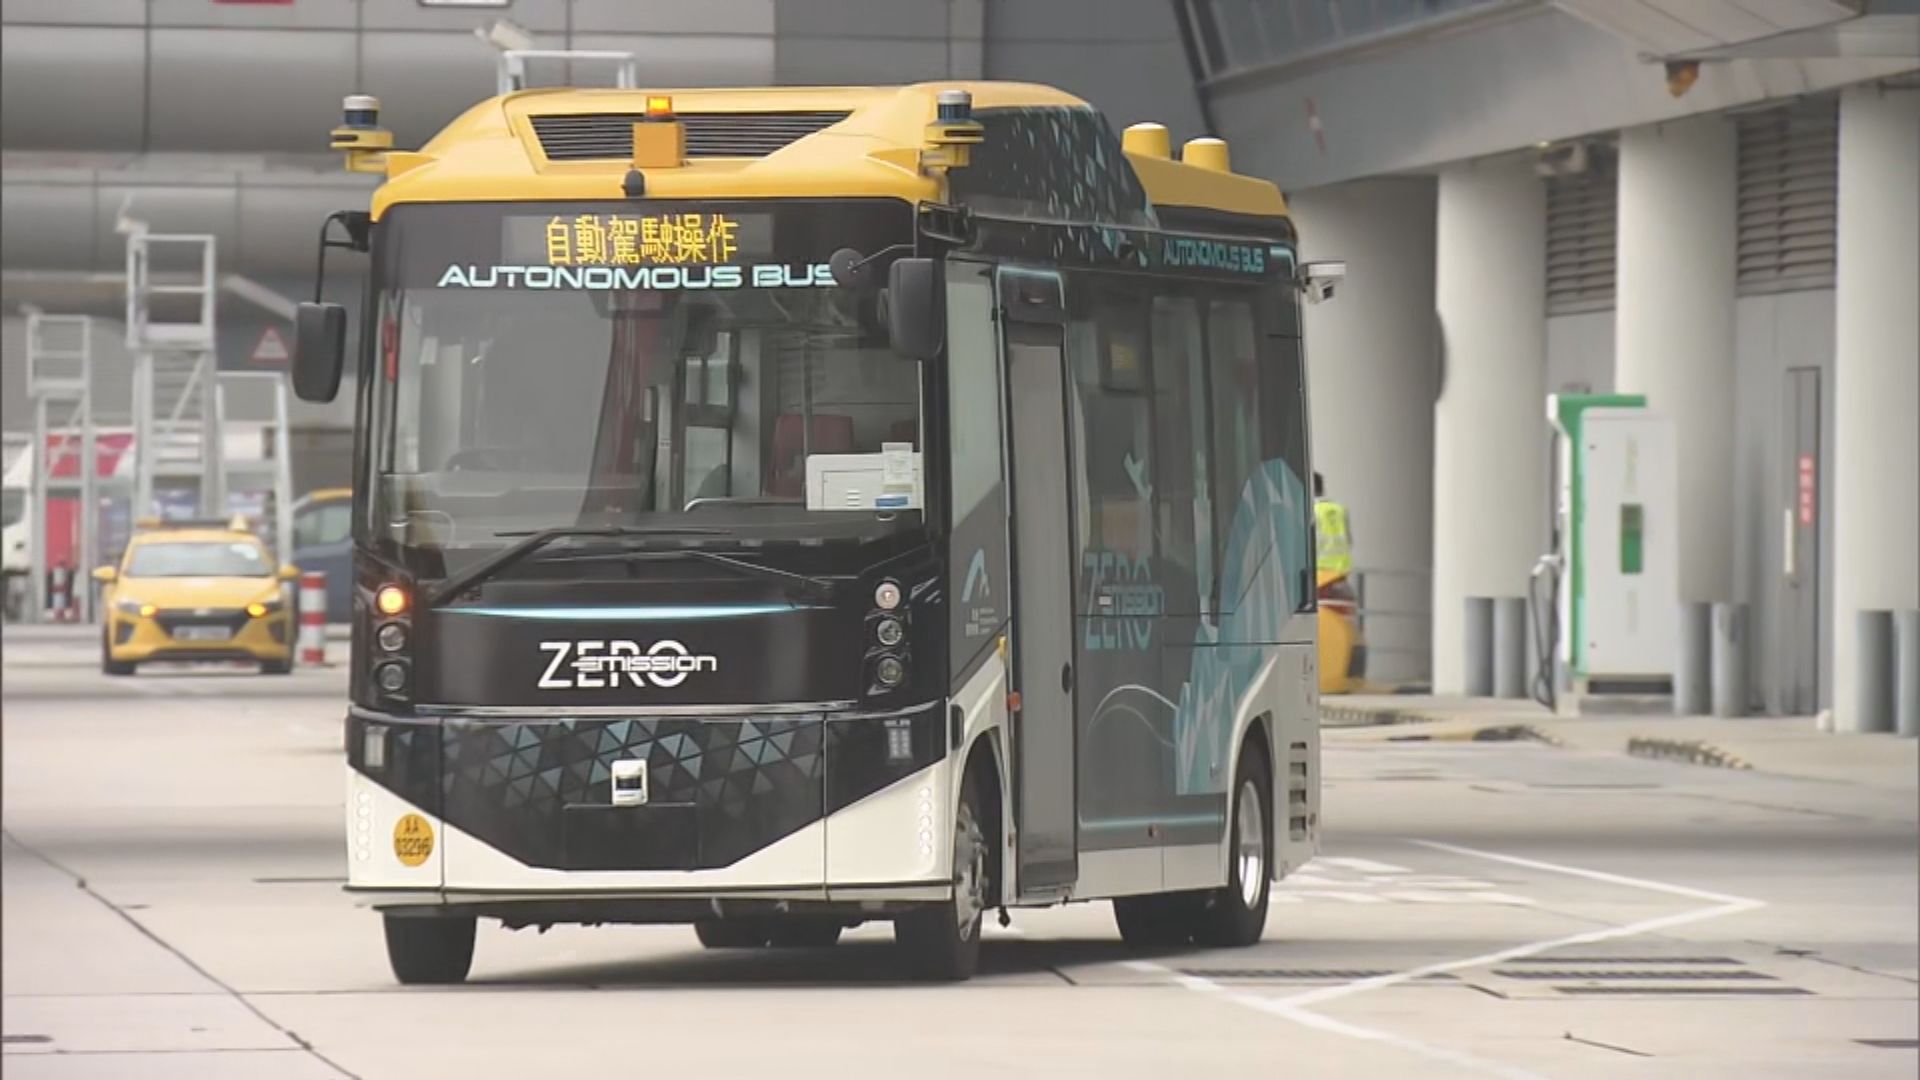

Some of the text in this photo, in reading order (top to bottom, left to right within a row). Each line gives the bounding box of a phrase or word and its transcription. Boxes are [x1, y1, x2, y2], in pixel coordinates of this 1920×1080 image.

[547, 214, 739, 264] 自動駕駛操作
[1163, 239, 1264, 273] AUTONOMOUS BUS
[437, 265, 743, 289] AUTONOMOUS
[1084, 552, 1152, 650] ZERO
[537, 640, 690, 688] ZERO
